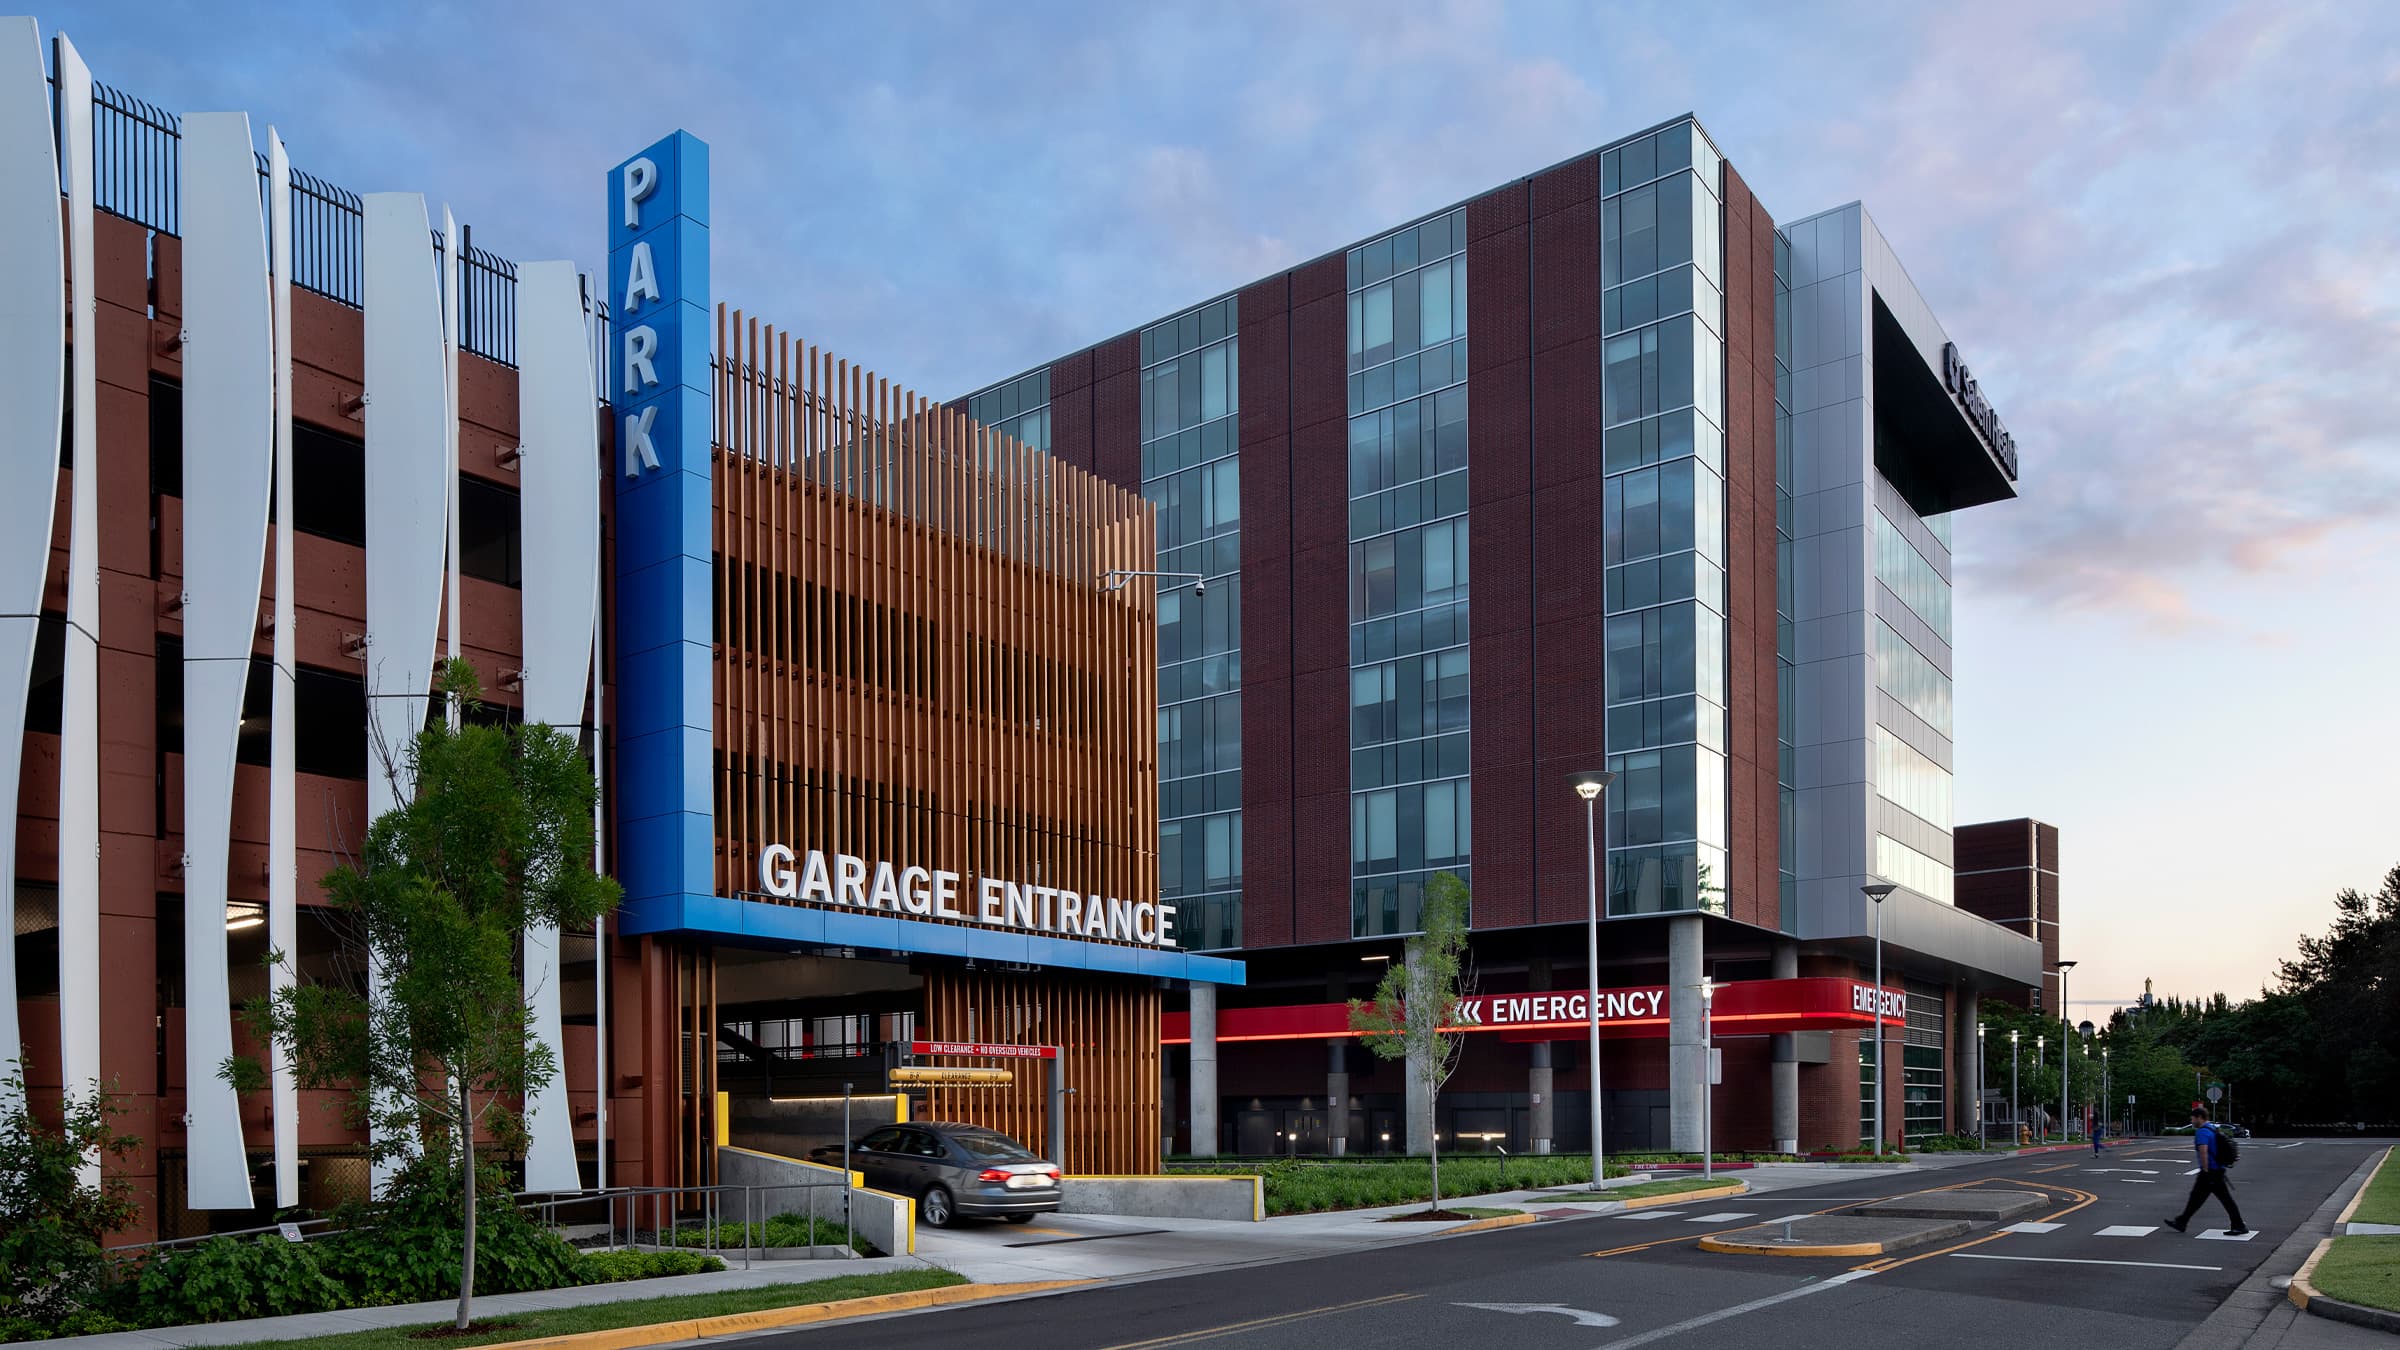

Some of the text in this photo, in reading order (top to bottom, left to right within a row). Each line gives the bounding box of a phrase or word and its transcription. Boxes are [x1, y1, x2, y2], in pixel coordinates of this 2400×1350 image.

[624, 157, 661, 479] PARK
[1958, 364, 1991, 441] Salem
[759, 843, 1177, 946] GARAGE ENTRANCE
[1493, 991, 1663, 1023] EMERGENCY
[1853, 984, 1906, 1018] EMERGENCY
[930, 1044, 1041, 1057] LOW CLEARANCE NO OVERSIZED VEHICLES
[941, 1071, 972, 1079] CLEARANCE
